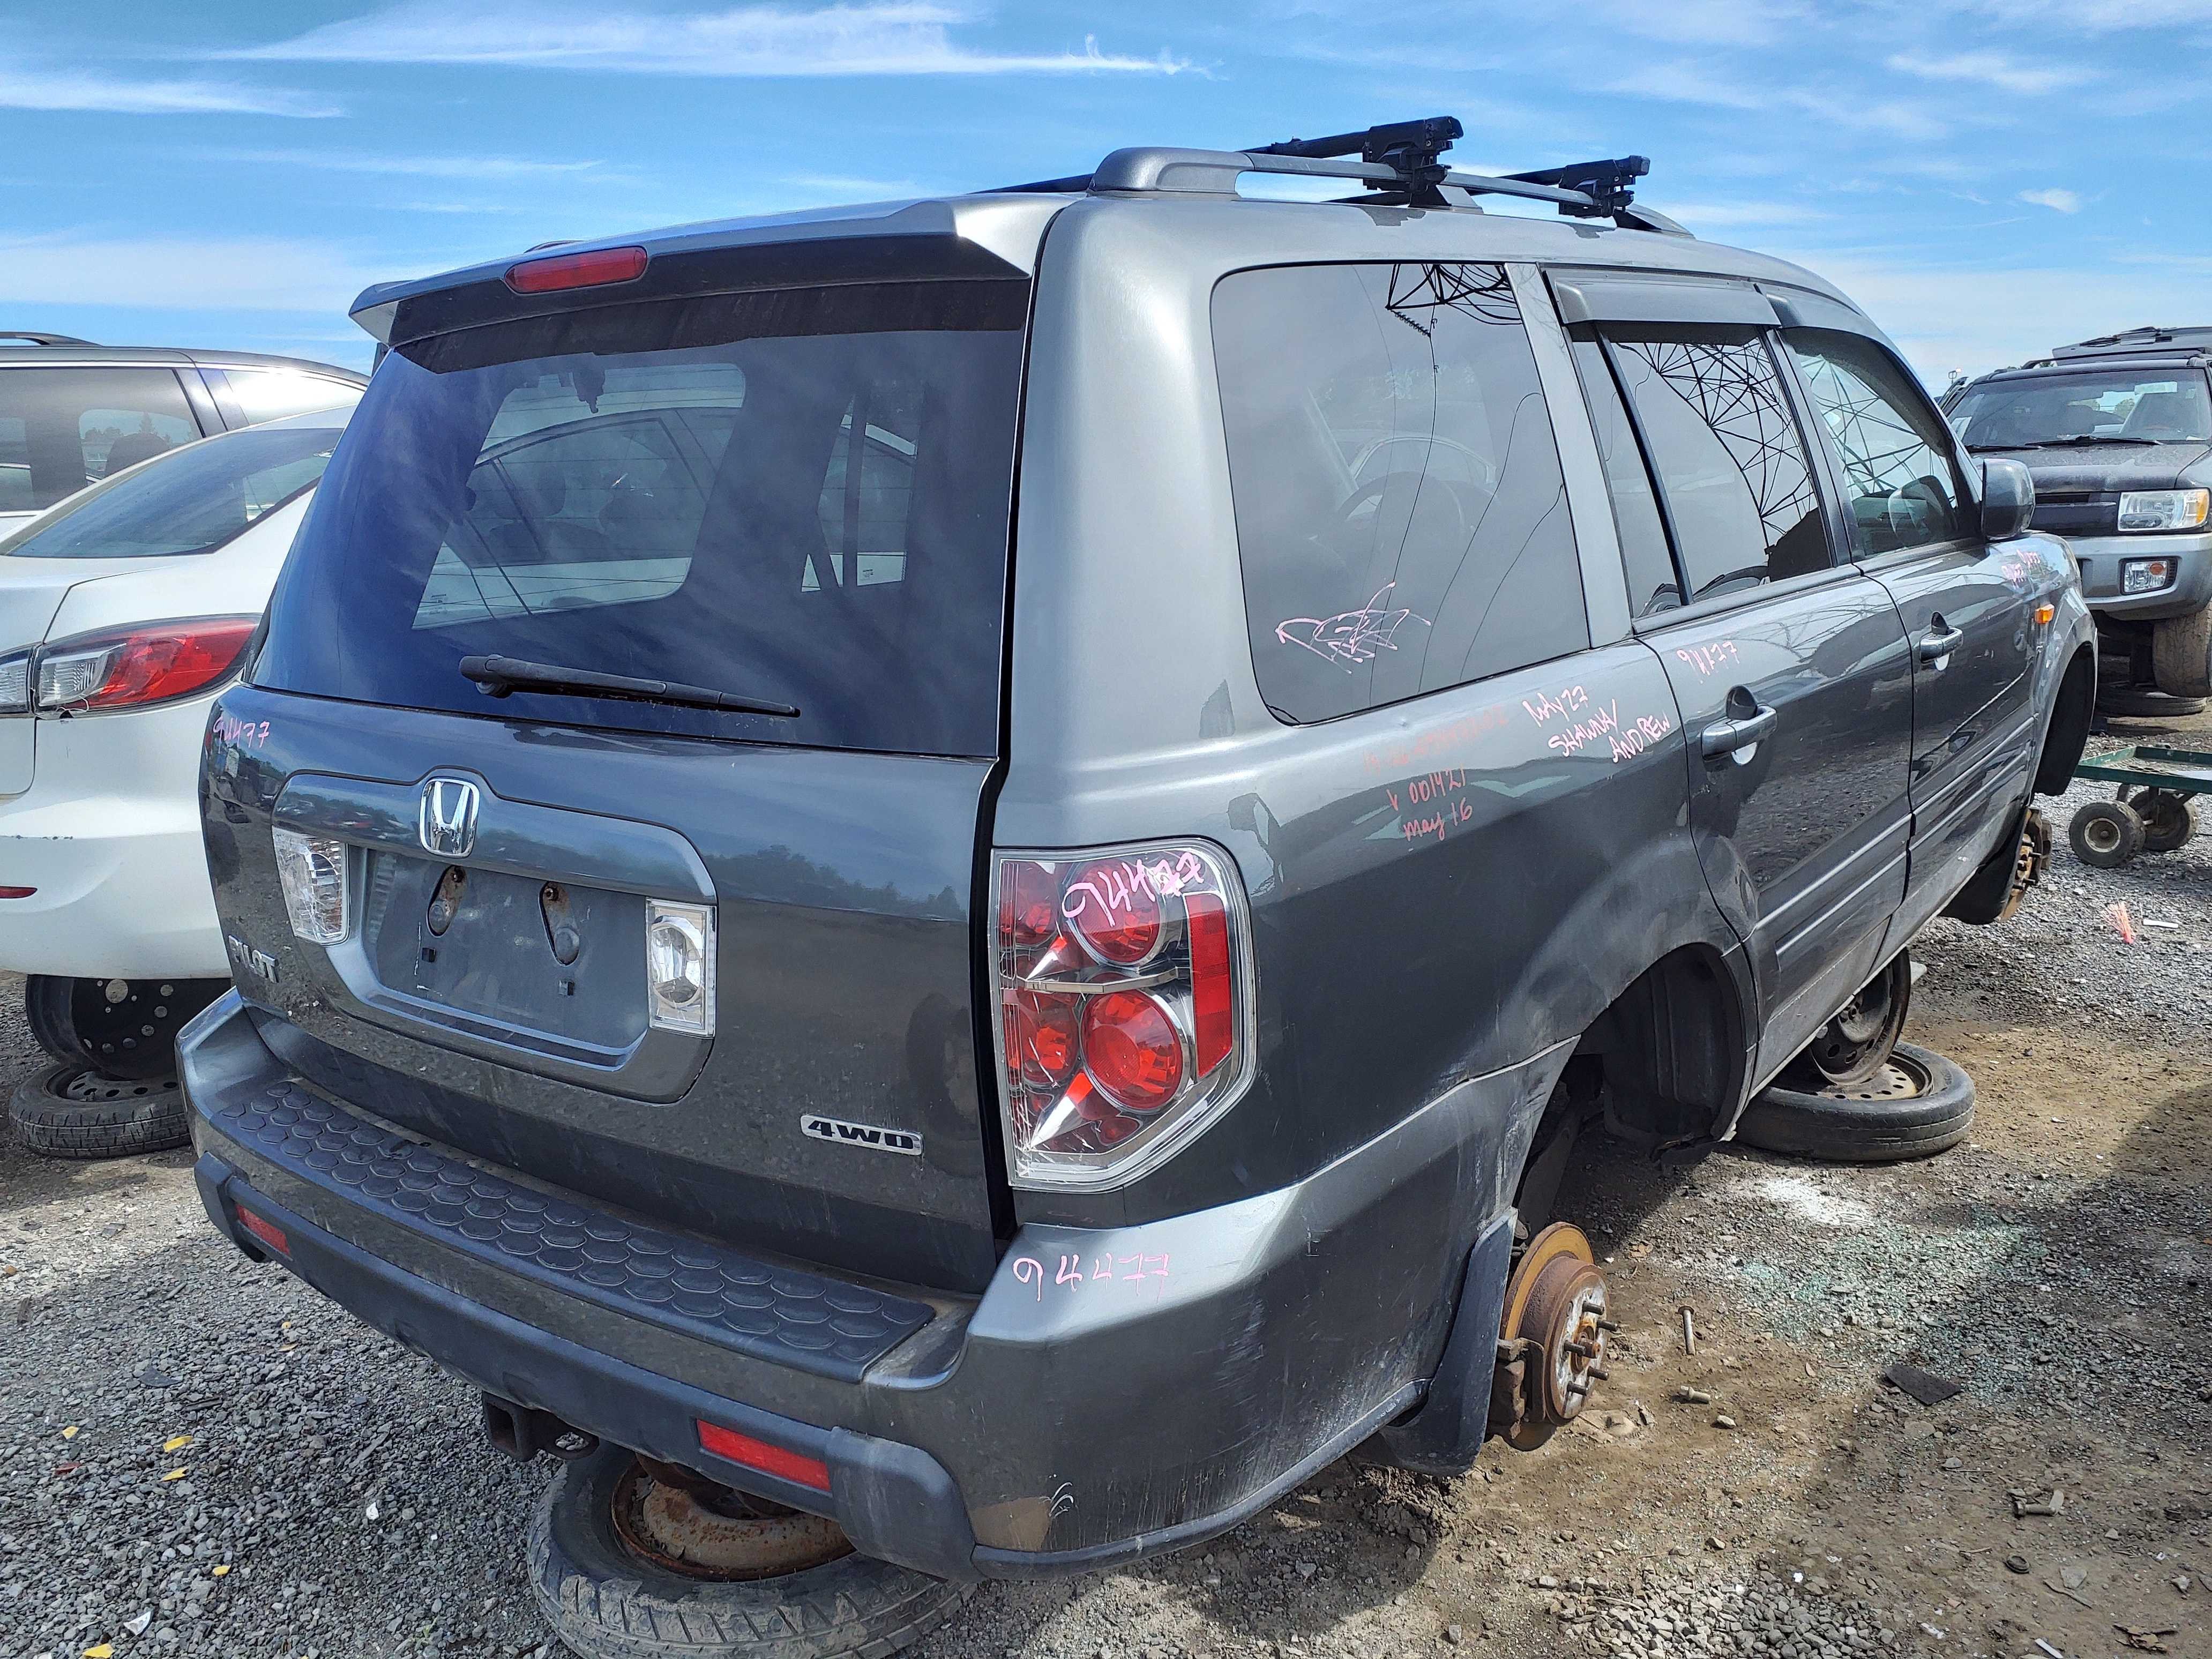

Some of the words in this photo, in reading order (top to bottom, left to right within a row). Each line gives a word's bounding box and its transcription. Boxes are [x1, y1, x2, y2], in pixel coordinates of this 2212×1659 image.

[1522, 693, 1570, 727] MAY
[1608, 709, 1670, 763] ANDREW
[1062, 852, 1204, 927] 94477
[228, 935, 279, 983] PILOT
[808, 1120, 913, 1149] 4WD
[1012, 1252, 1169, 1303] 94477
